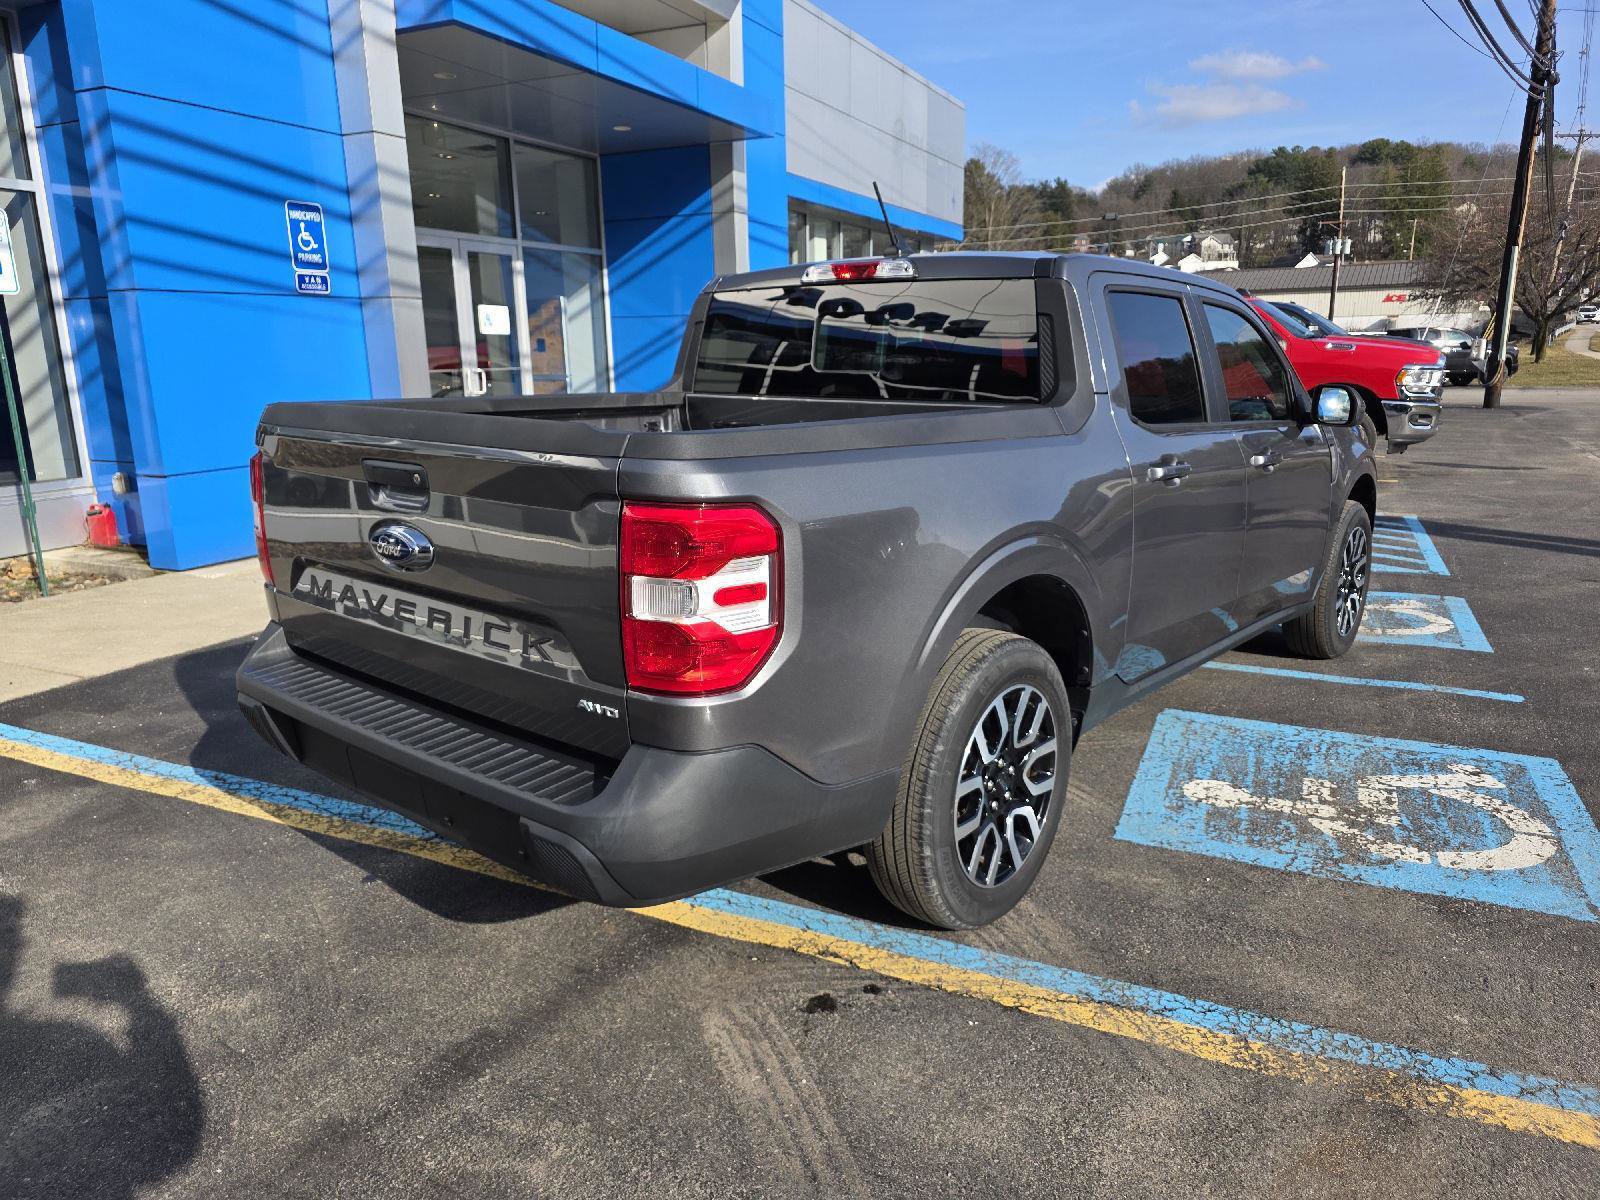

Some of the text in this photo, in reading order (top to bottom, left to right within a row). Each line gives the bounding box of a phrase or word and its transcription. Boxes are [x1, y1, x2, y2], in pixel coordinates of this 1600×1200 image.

[298, 252, 322, 264] PARKING
[304, 275, 322, 284] VAN
[1381, 293, 1407, 302] ACE
[376, 535, 401, 557] Ford
[309, 574, 554, 662] MAVERICK
